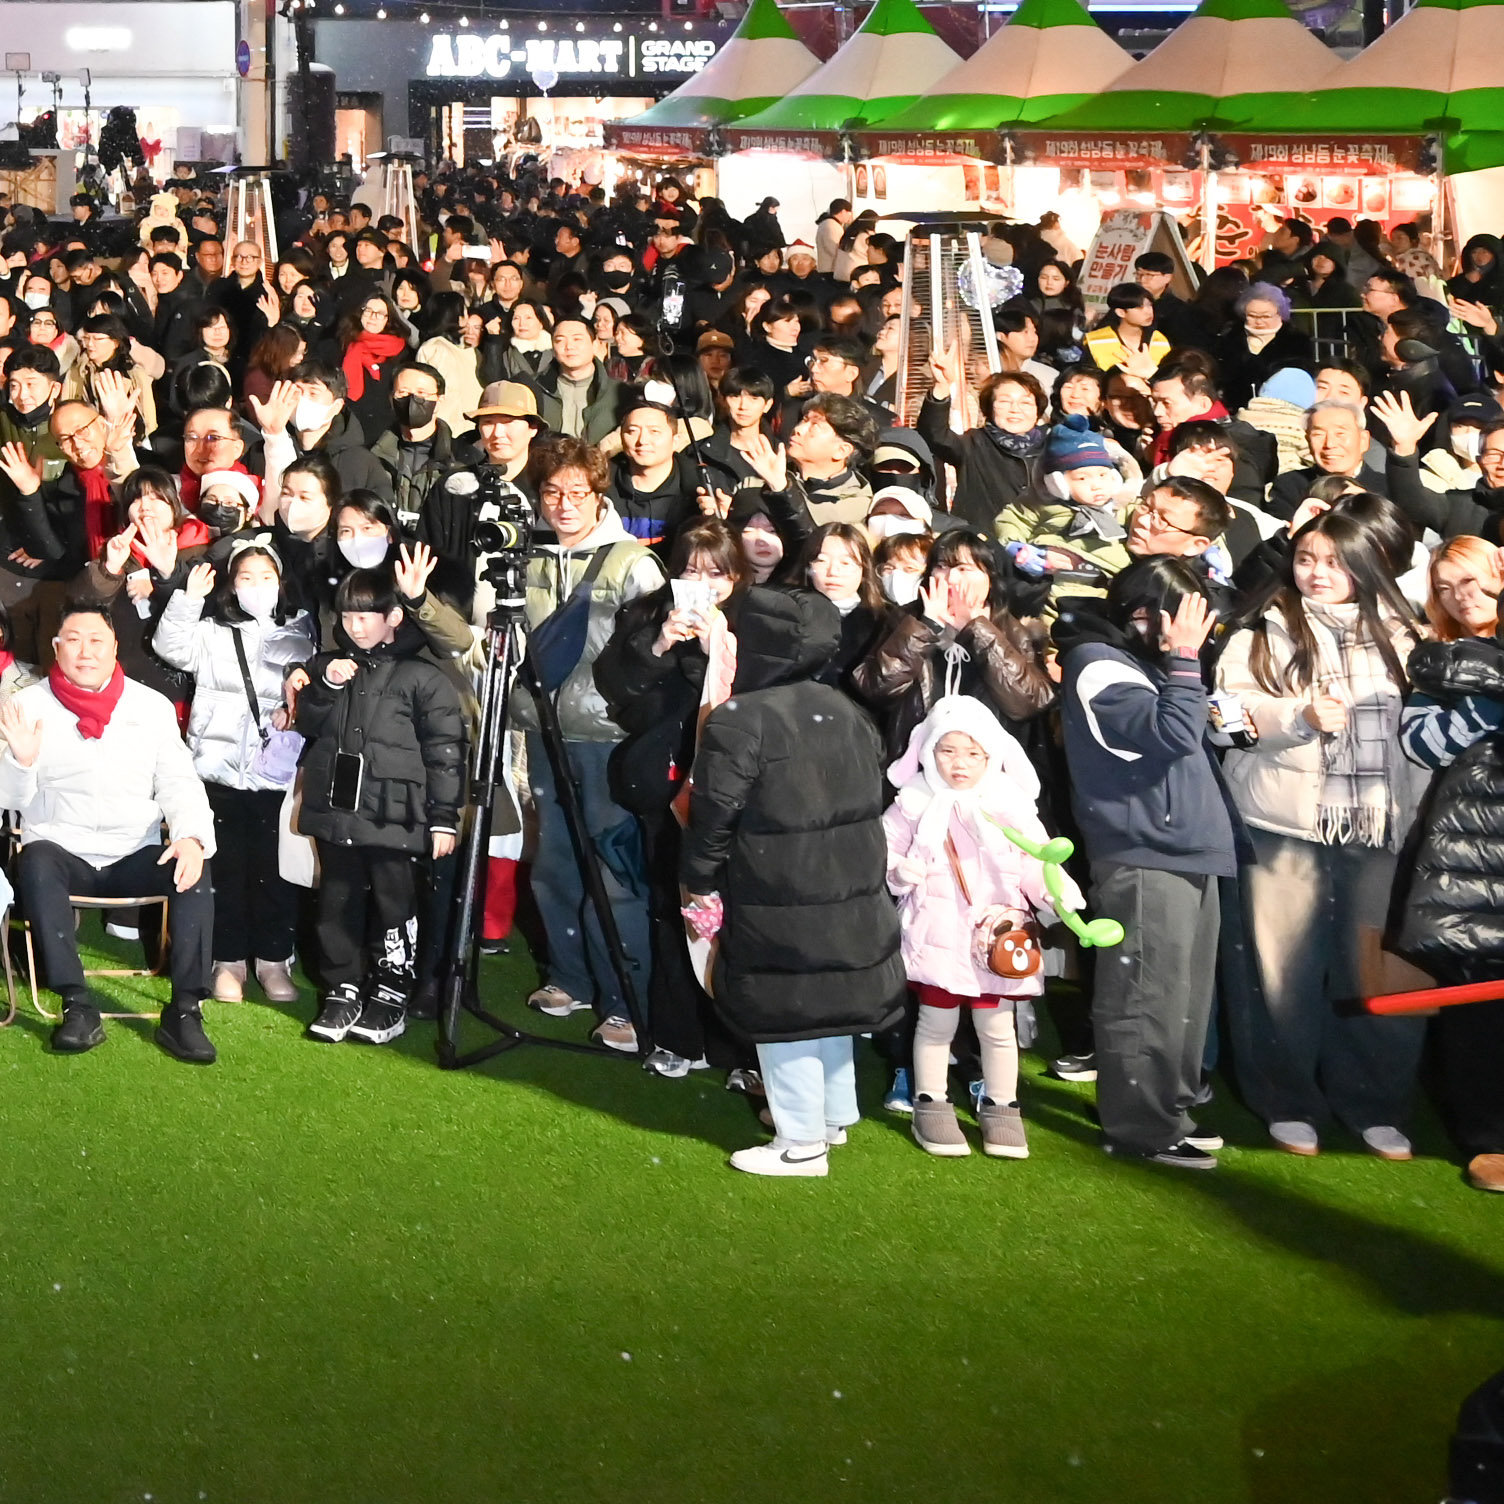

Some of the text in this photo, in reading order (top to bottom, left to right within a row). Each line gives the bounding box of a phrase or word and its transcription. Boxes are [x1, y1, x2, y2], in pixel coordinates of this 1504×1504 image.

[426, 34, 623, 77] ABC-MART
[641, 40, 716, 56] GRAND
[642, 56, 706, 73] STAGE
[1095, 242, 1137, 263] 눈사람
[1087, 261, 1129, 281] 만들기
